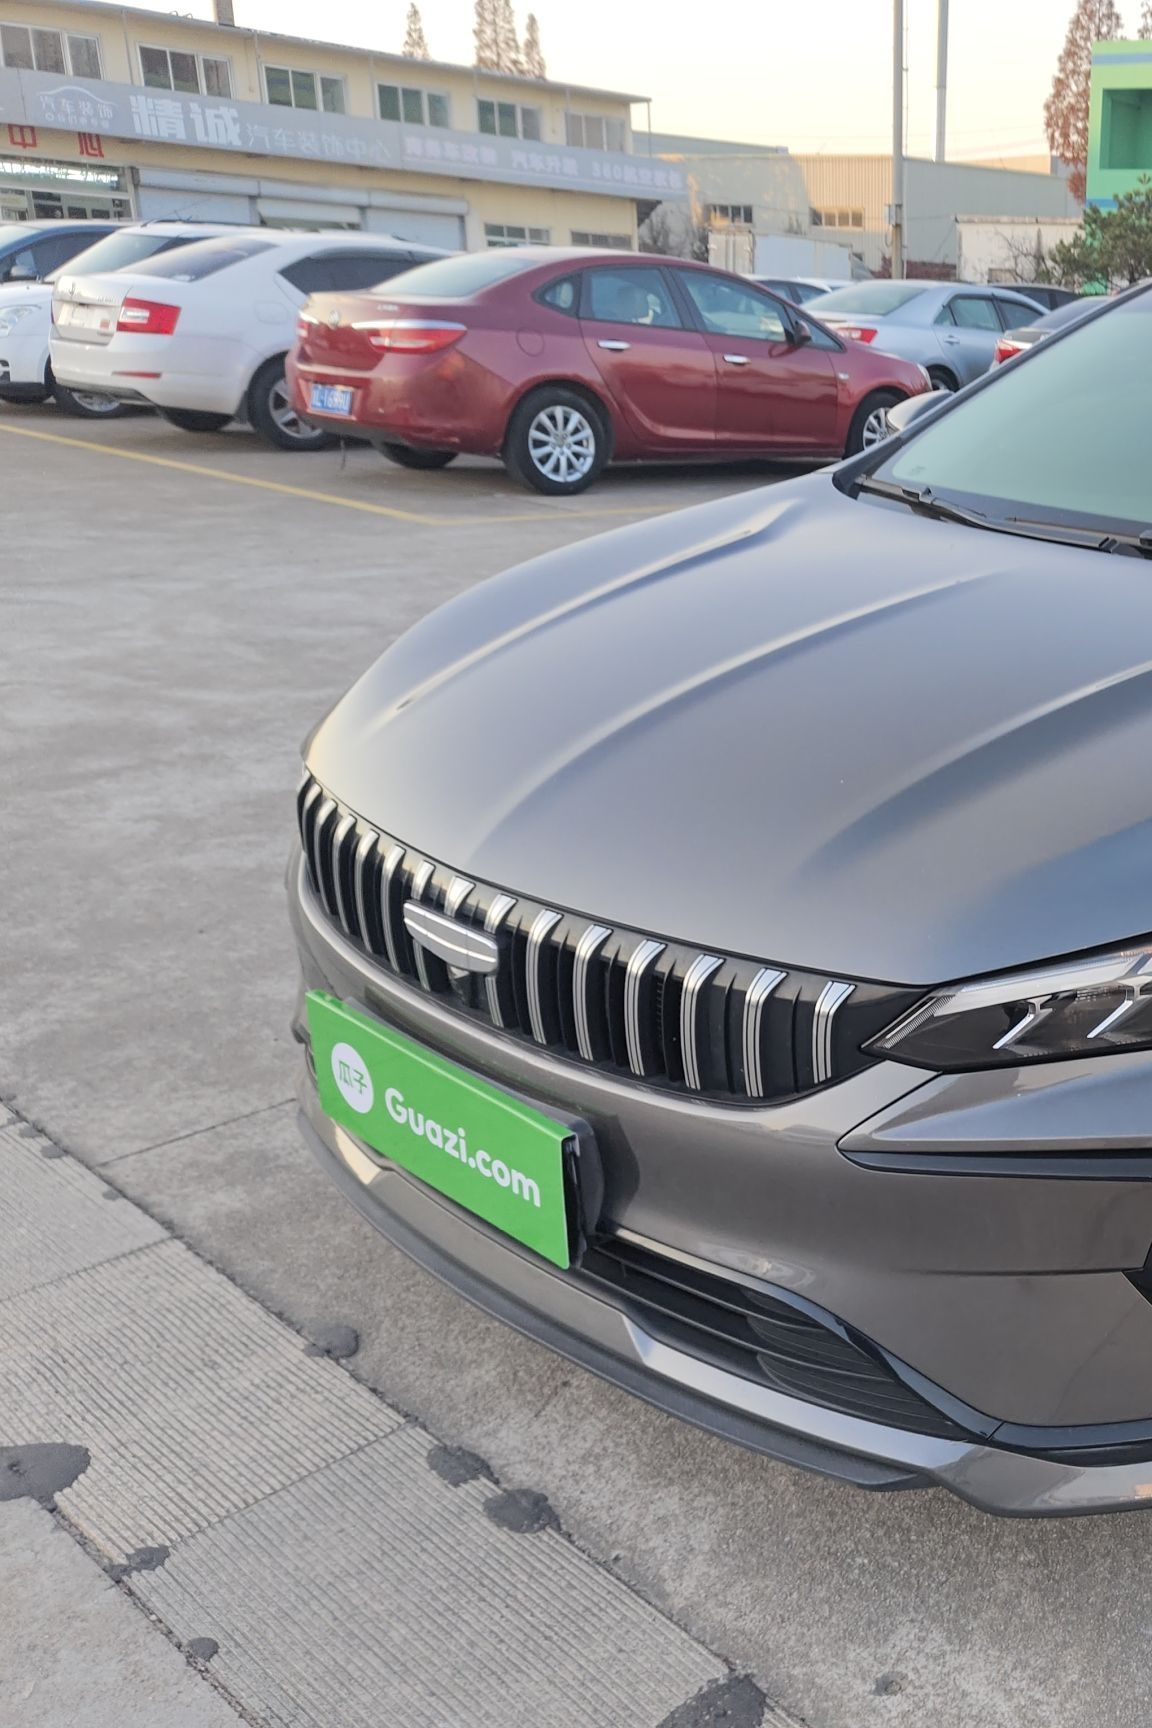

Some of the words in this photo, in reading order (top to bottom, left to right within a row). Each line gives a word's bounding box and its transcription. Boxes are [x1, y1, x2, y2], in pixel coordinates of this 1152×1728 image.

[129, 95, 242, 146] 精诚
[338, 1059, 368, 1096] 瓜子
[384, 1087, 541, 1208] Guazi.com
